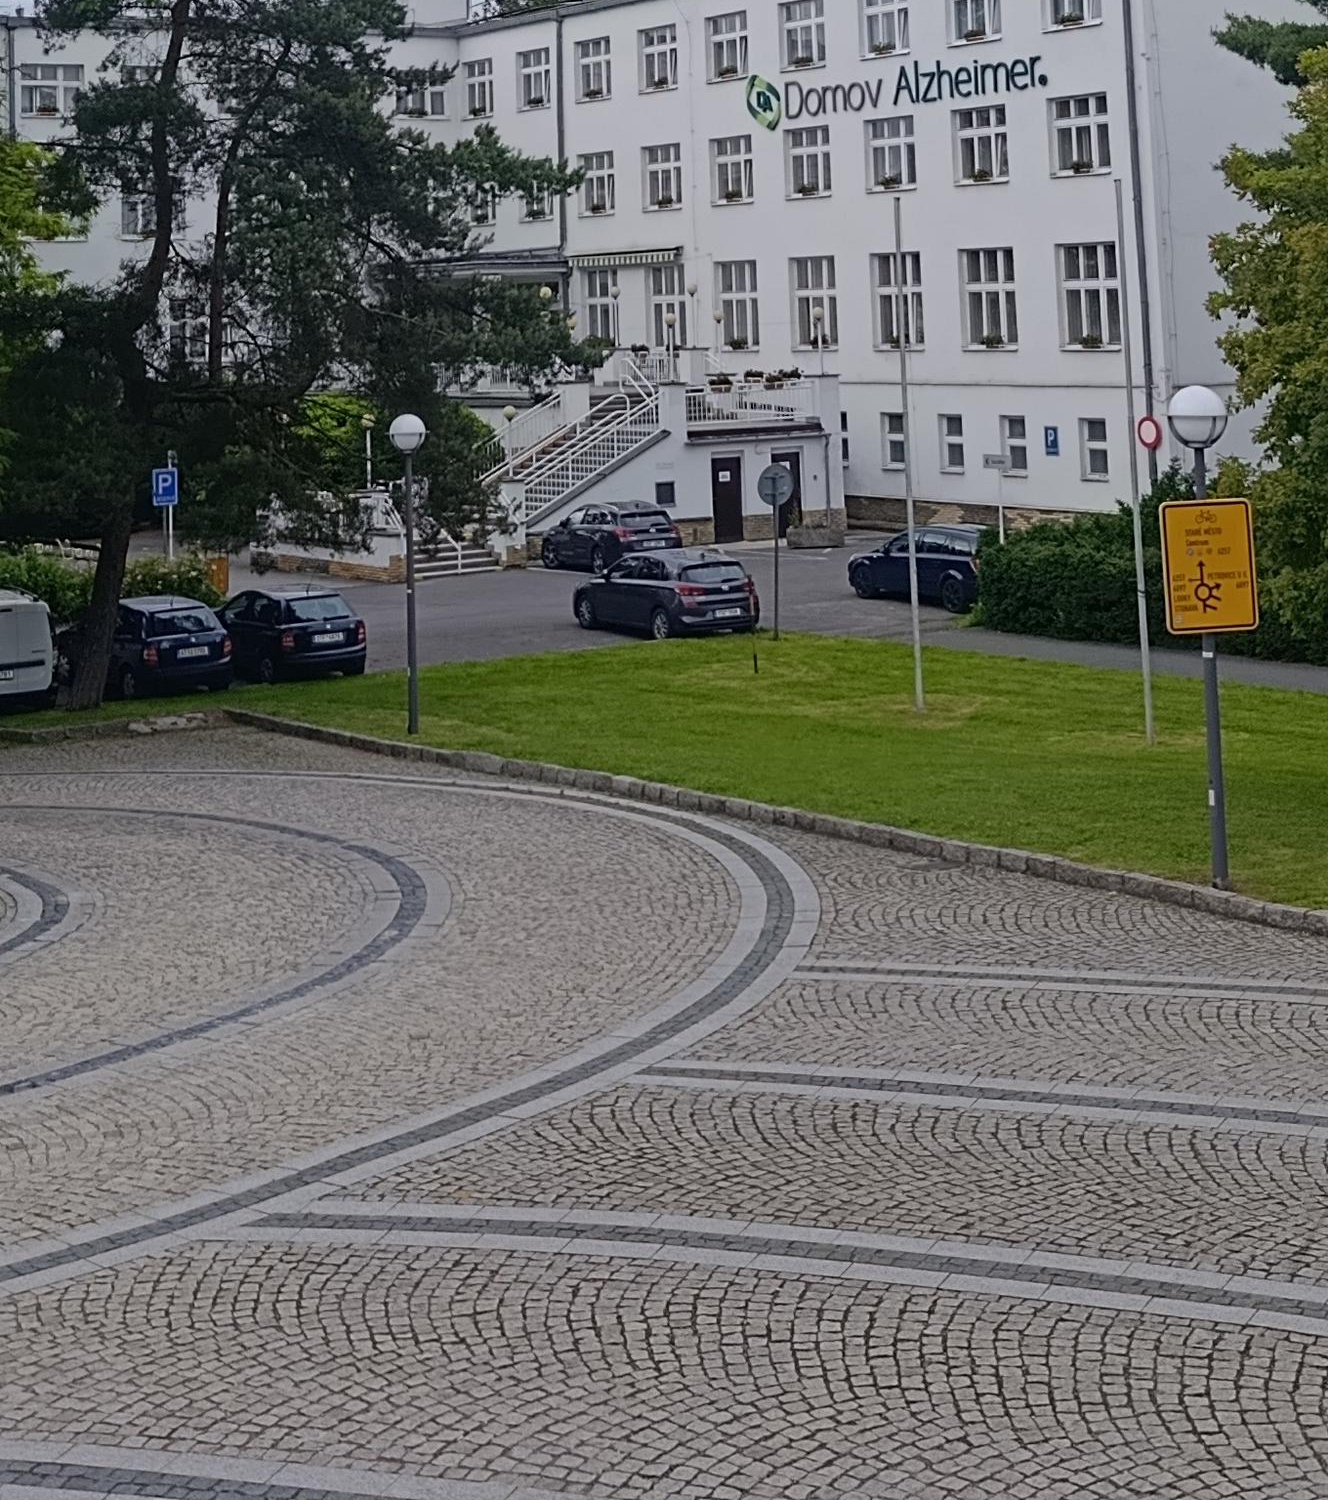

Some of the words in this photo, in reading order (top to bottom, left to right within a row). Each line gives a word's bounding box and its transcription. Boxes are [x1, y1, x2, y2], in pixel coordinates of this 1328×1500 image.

[784, 78, 883, 119] Domov
[893, 55, 1048, 105] Alzheimer.
[1047, 429, 1055, 446] P
[158, 474, 172, 495] P
